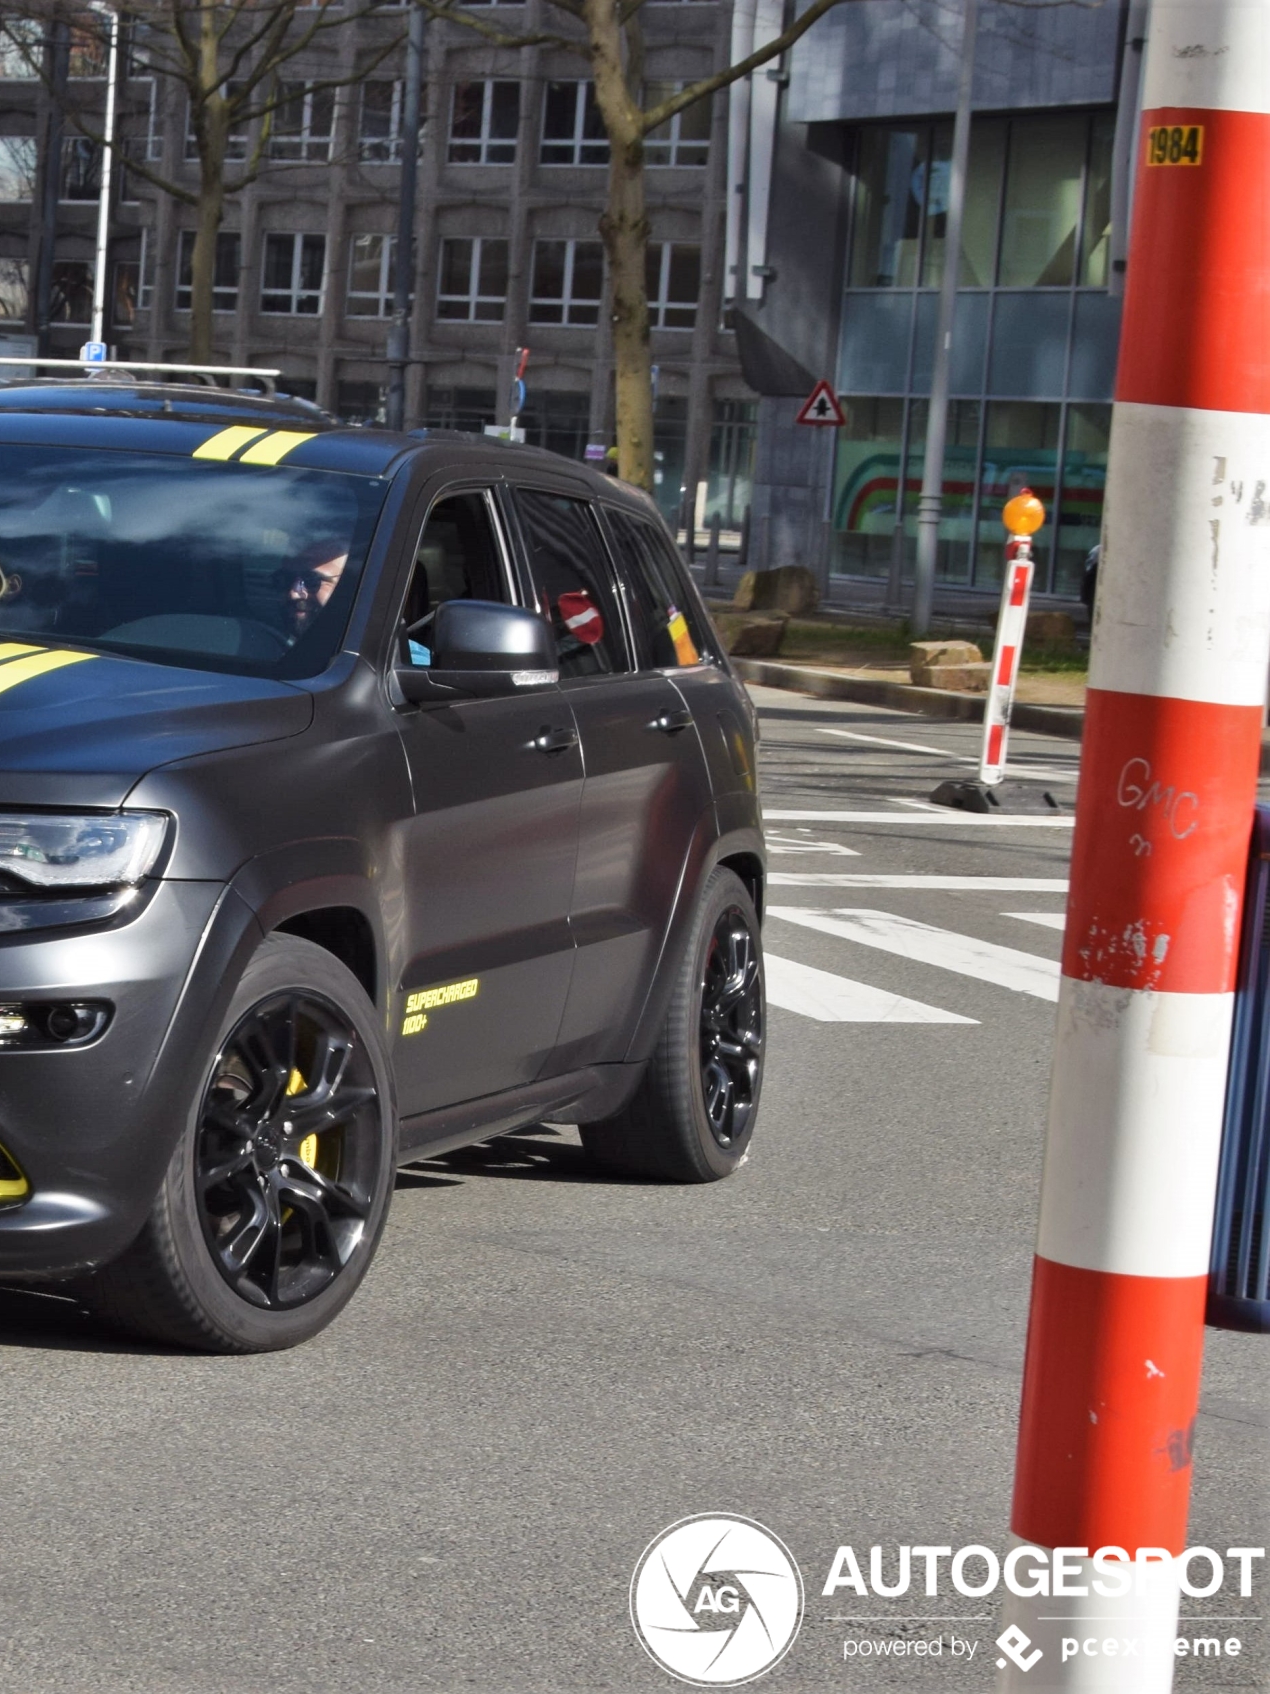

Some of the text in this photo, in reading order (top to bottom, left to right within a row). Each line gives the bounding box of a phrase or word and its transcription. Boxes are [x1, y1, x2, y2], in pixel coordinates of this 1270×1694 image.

[1149, 126, 1199, 164] 1984
[89, 345, 101, 360] P
[405, 978, 479, 1014] SUPERCHARGED
